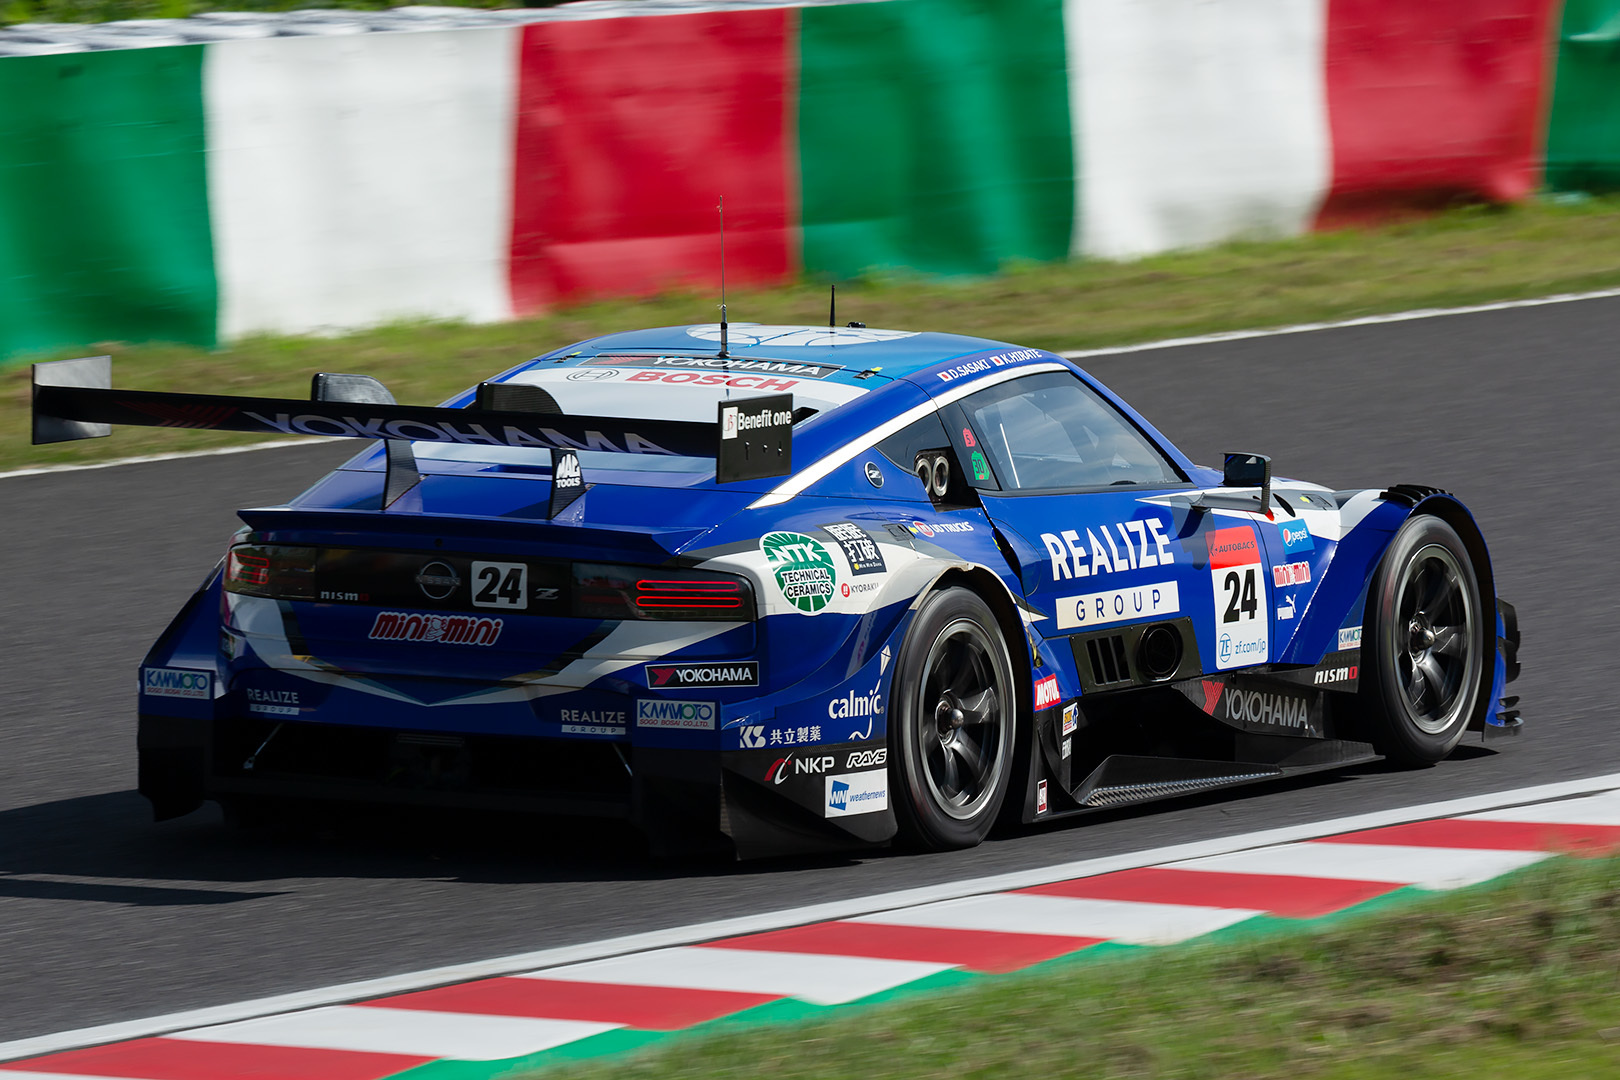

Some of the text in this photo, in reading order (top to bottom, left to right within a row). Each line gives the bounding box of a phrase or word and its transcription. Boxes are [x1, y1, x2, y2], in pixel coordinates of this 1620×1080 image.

[1001, 349, 1042, 365] K.HIRATE
[653, 357, 821, 376] YOKOHAMA
[948, 359, 992, 379] D.SASAKI
[625, 371, 799, 391] BOSCH
[737, 409, 792, 431] Benefit one
[242, 411, 682, 456] YOKOHAMA
[556, 477, 580, 488] TOOLS
[942, 521, 974, 532] TRUCKS
[1291, 527, 1309, 544] pepsi
[772, 541, 823, 563] NTK
[1040, 517, 1175, 581] REALIZE
[1219, 540, 1255, 553] AUTOBACS
[415, 575, 462, 587] NISSAN
[475, 566, 524, 605] 24
[782, 569, 831, 584] TECHNICAL
[320, 590, 370, 602] nismo
[787, 582, 832, 598] CERAMICS
[1223, 568, 1258, 624] 24
[1076, 588, 1161, 621] GROUP
[1235, 637, 1267, 655] zf.com/jp
[676, 667, 753, 683] YOKOHAMA
[1314, 666, 1358, 684] nismo
[247, 688, 300, 704] REALIZE
[1037, 678, 1060, 706] MOTUL
[255, 705, 293, 714] GROUP
[560, 709, 626, 724] REALIZE
[1225, 687, 1309, 729] YOKOHAMA
[570, 726, 617, 734] GROUP
[769, 725, 822, 746] 共立製薬
[795, 756, 835, 774] NKP
[846, 748, 887, 768] RAYS
[850, 790, 886, 802] weathernews
